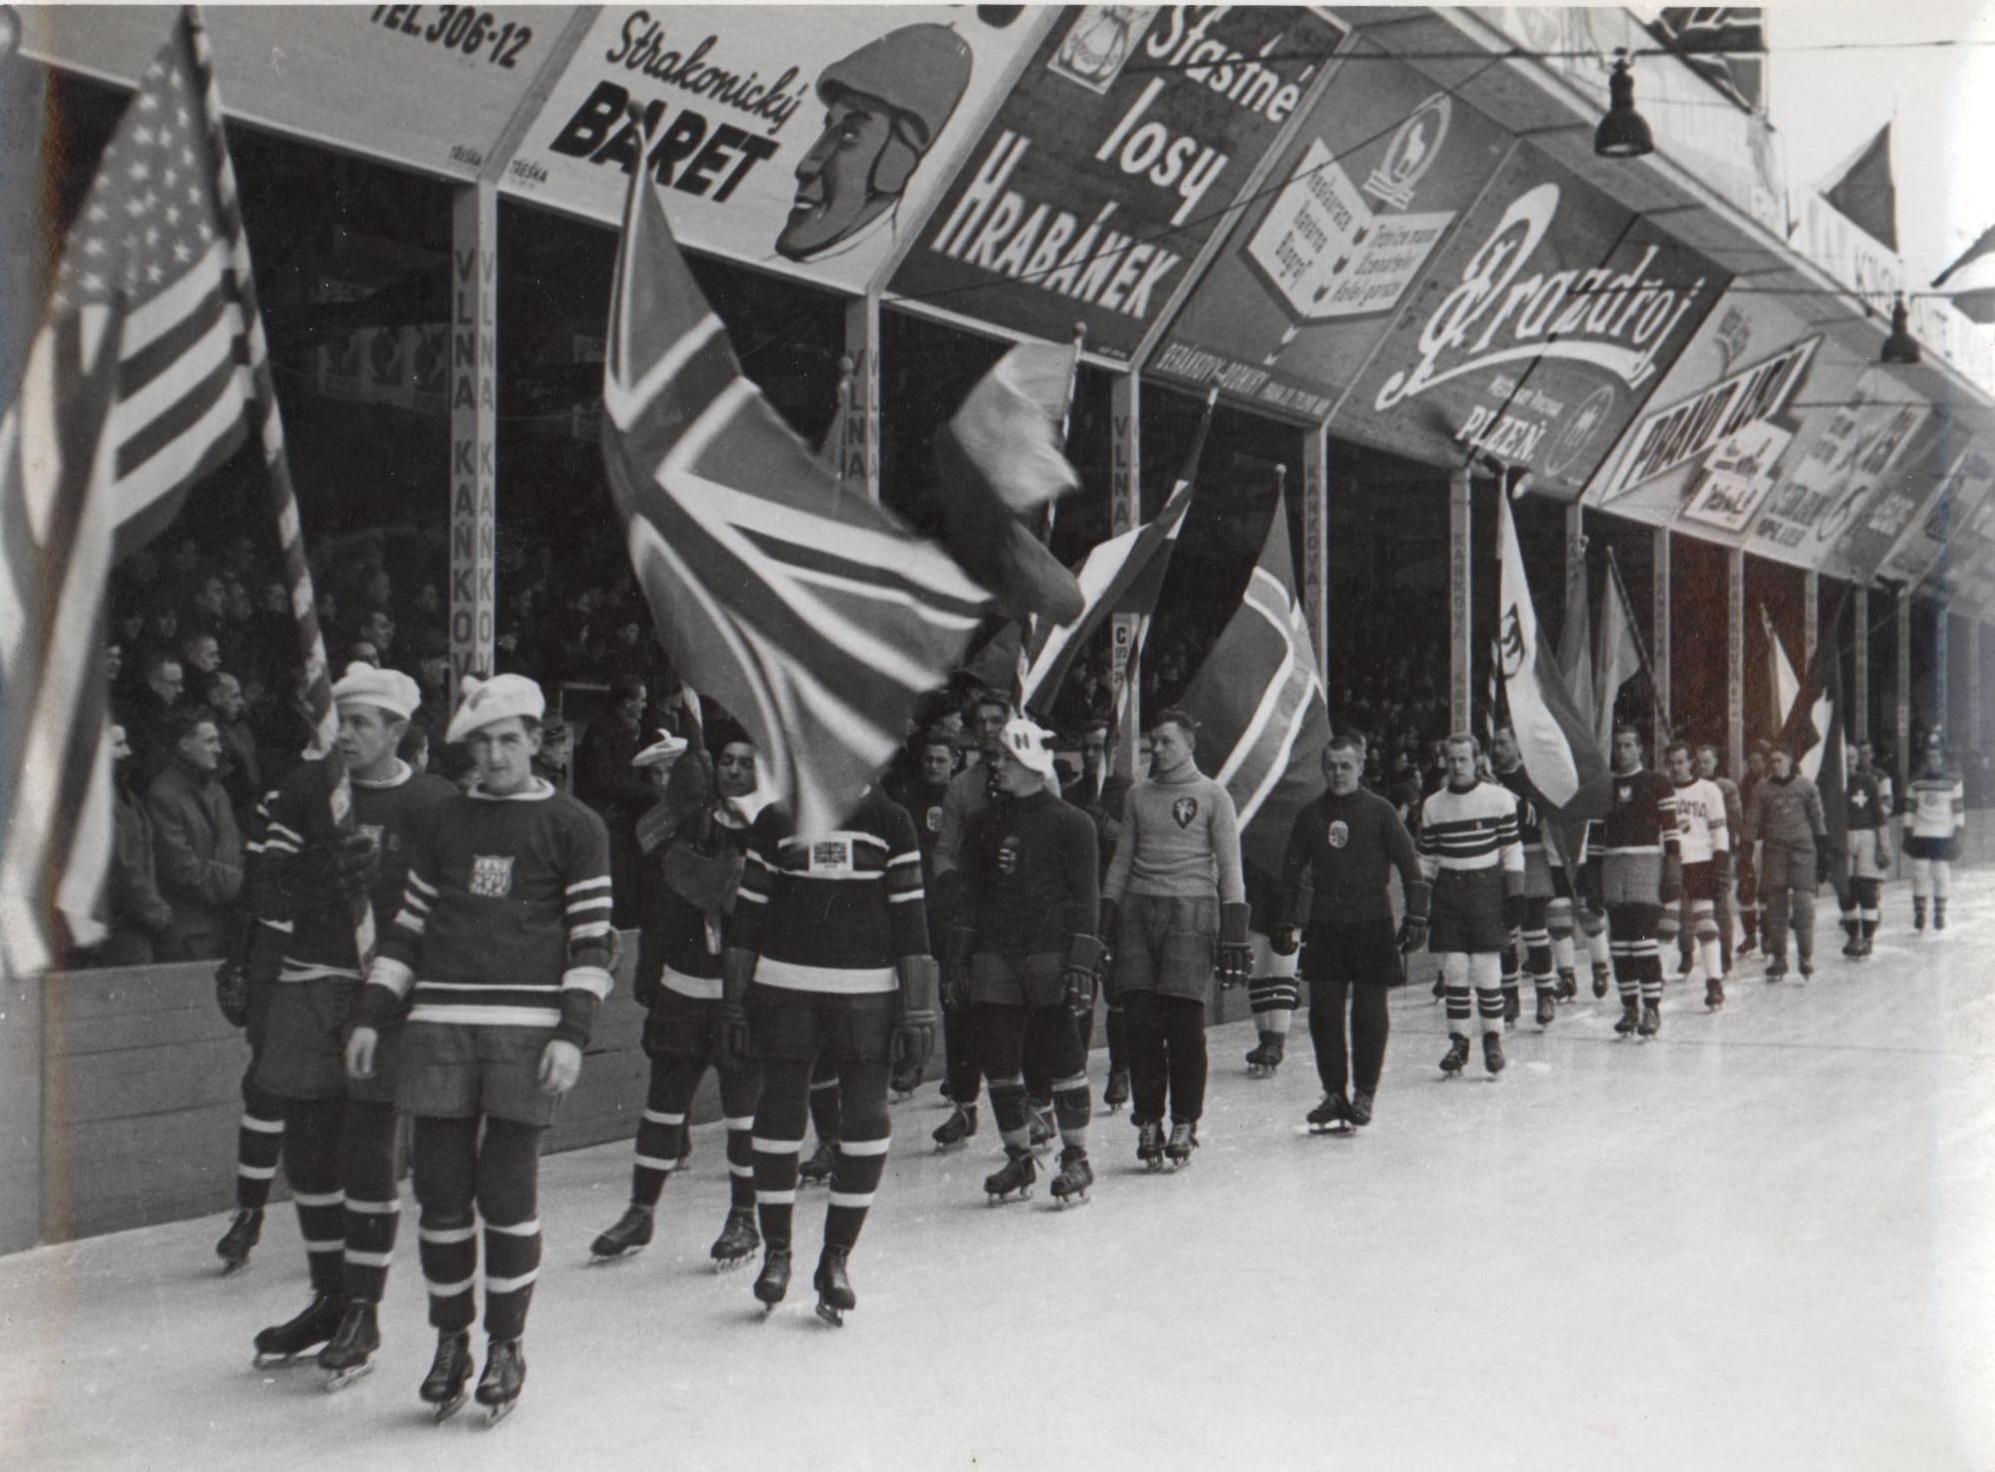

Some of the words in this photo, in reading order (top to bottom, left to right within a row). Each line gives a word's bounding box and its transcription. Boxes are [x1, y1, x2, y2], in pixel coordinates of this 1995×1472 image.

[425, 5, 532, 69] 306-12
[606, 10, 809, 134] Strakonický
[549, 80, 781, 203] BARET
[1096, 76, 1229, 226] losy
[931, 130, 1181, 319] HRABÁNEK
[453, 248, 475, 411] VLNA
[1374, 183, 1704, 411] Prazdroj
[1113, 415, 1130, 527] VLNA
